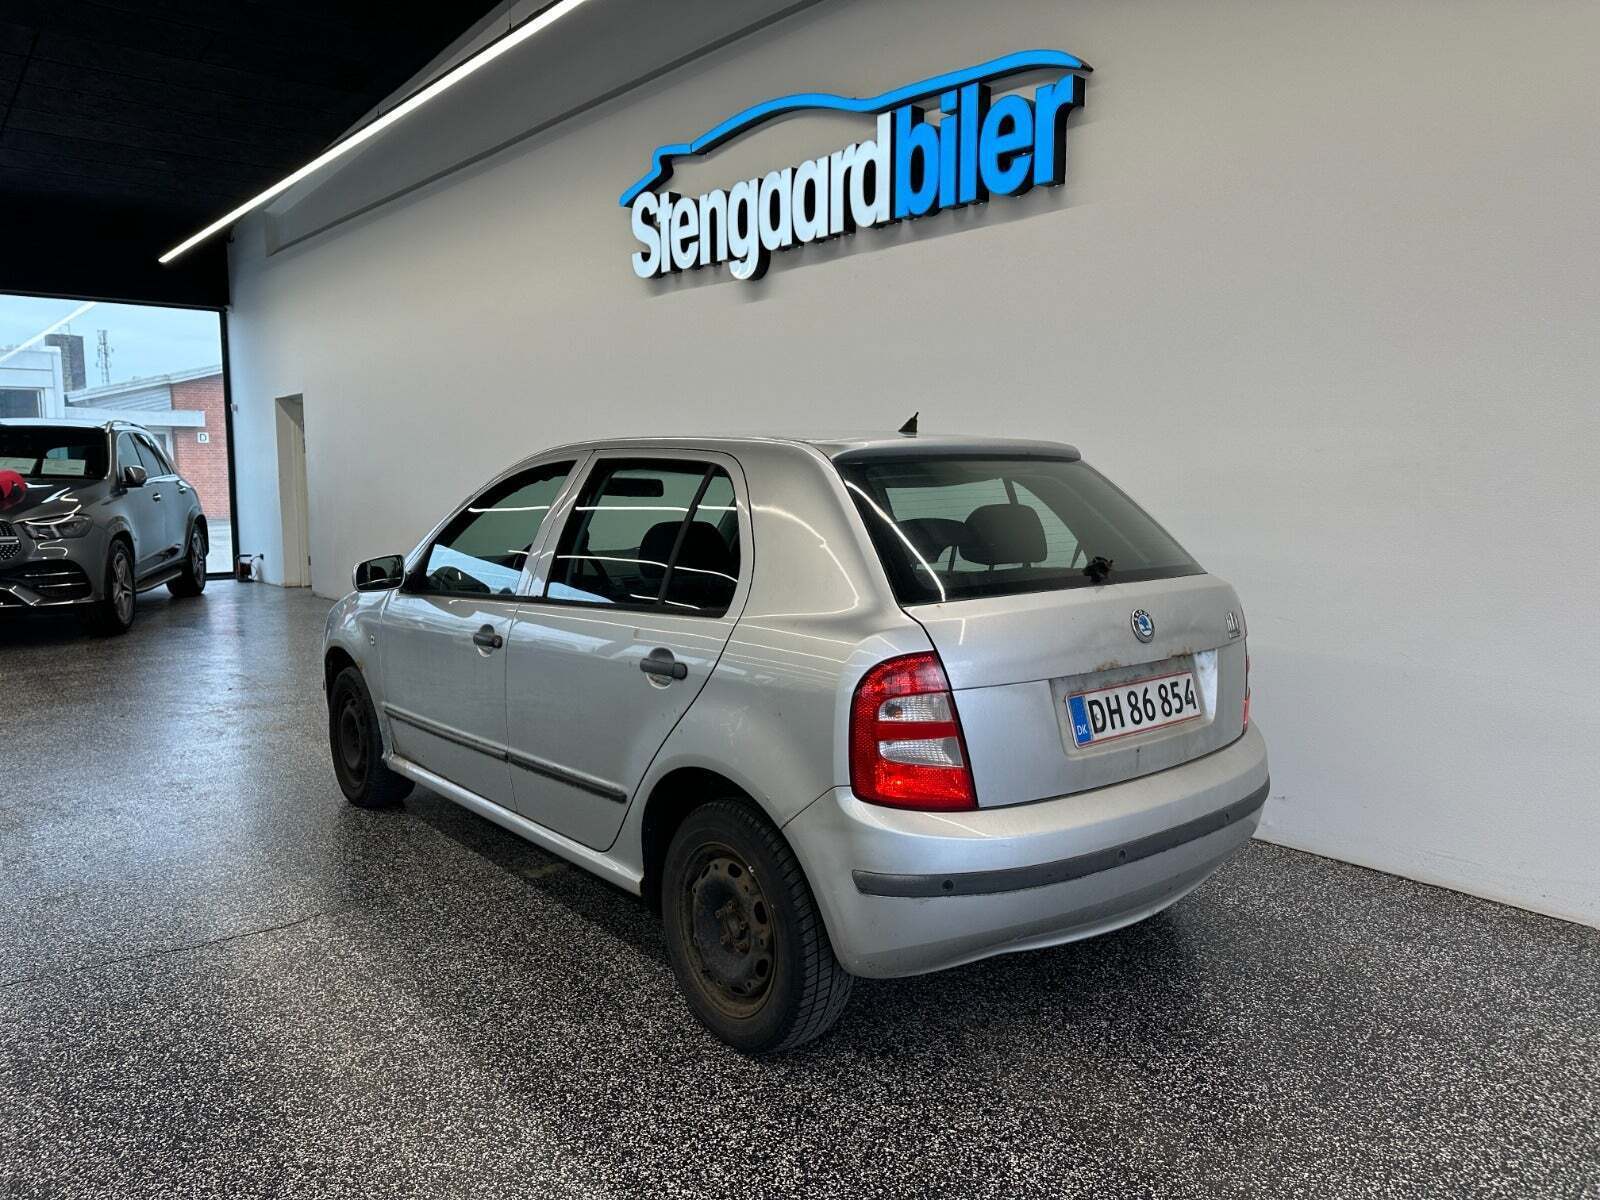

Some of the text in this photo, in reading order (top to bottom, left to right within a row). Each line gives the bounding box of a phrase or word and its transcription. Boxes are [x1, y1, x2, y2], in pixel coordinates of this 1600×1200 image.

[199, 433, 207, 441] D
[1087, 678, 1197, 734] DH 86 854
[1076, 724, 1088, 736] DK
